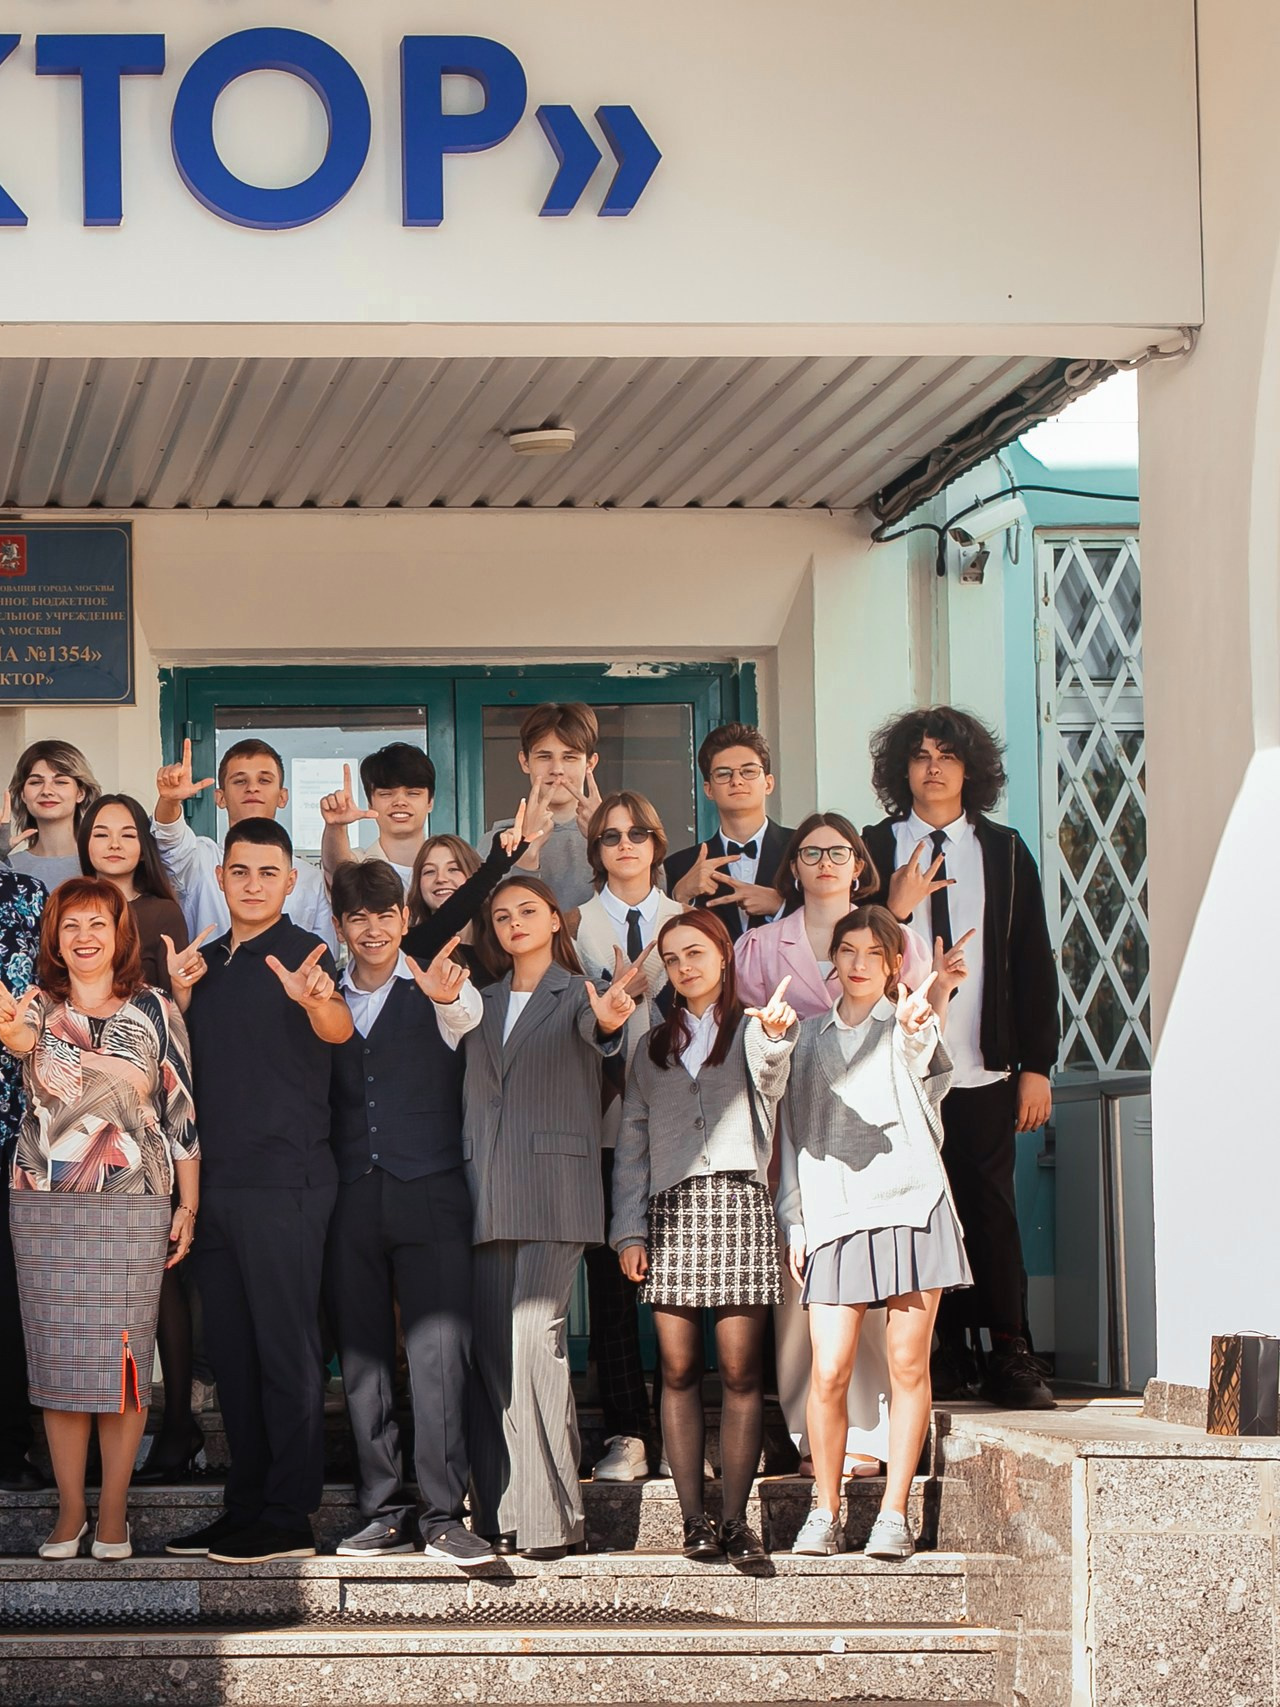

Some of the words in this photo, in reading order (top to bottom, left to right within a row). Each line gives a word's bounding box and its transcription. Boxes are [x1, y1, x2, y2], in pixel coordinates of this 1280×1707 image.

[32, 597, 108, 606] БЮДЖЕТНОЕ
[45, 611, 126, 621] УЧРЕЖДЕНИЕ
[9, 626, 62, 635] МОСКВЫ
[24, 646, 103, 663] №1354»
